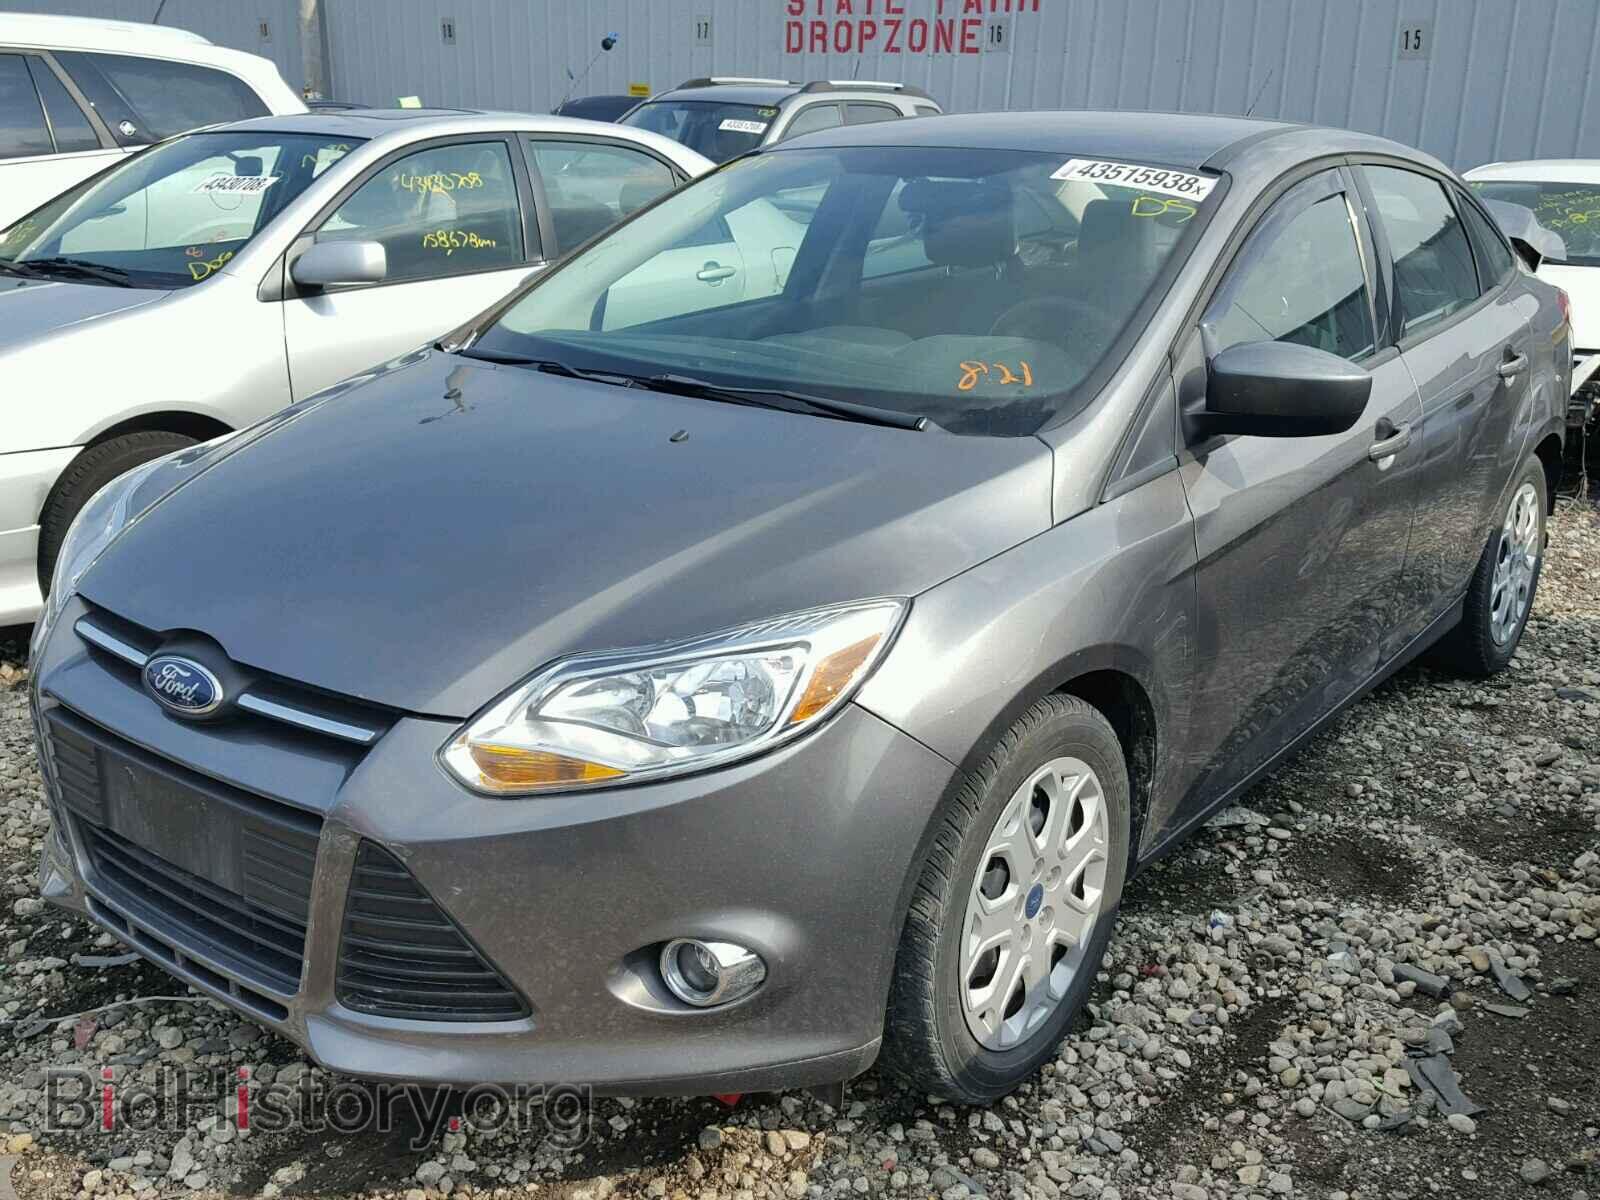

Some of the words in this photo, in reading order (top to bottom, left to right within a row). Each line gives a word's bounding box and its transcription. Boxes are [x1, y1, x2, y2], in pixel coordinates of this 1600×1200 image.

[696, 22, 709, 40] 17
[785, 19, 982, 53] DROPZONE
[989, 25, 1003, 43] 16
[1404, 29, 1422, 50] 15
[155, 663, 200, 702] Ford
